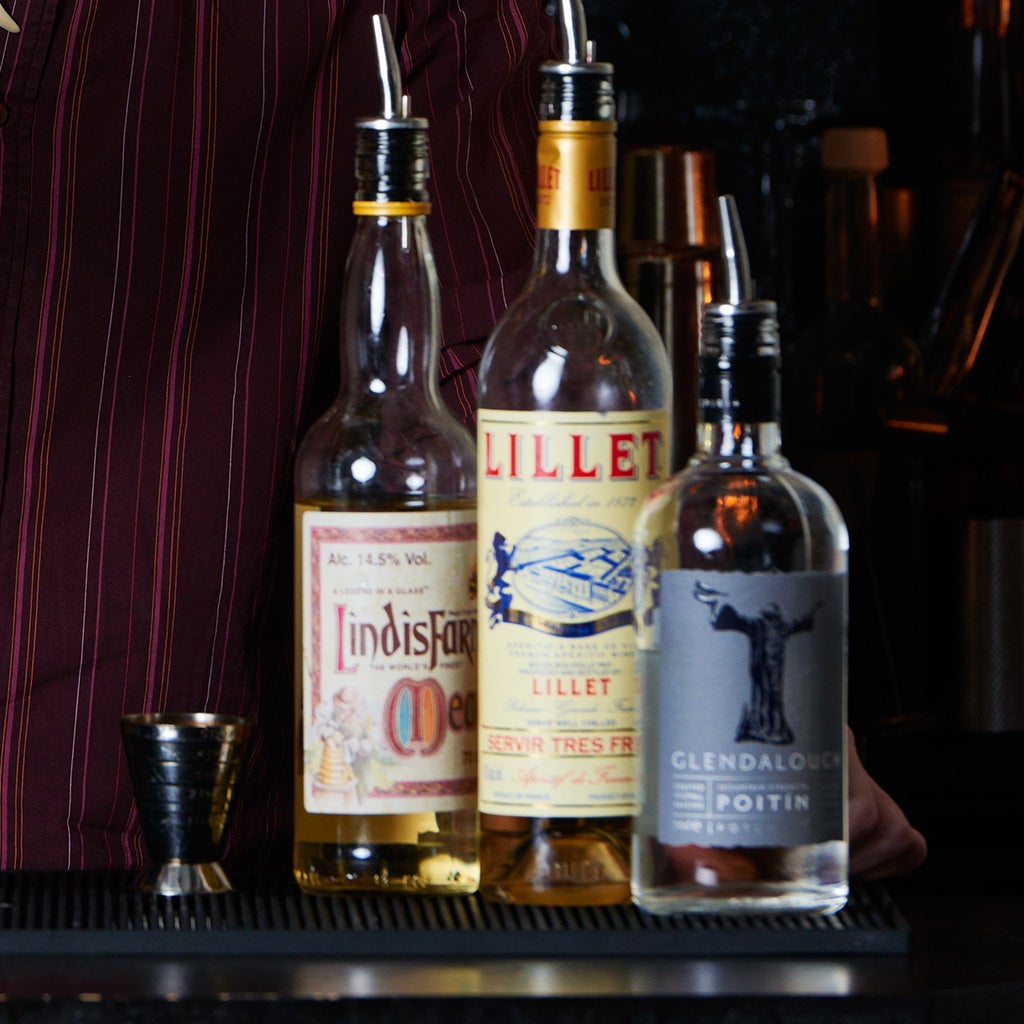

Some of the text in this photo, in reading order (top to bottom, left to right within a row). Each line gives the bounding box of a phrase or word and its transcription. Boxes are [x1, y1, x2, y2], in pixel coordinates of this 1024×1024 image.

[484, 431, 664, 481] LILLET
[328, 551, 431, 567] Alc. 14.5% Vol.
[532, 678, 611, 696] LILLET
[487, 734, 544, 753] SERVIR
[551, 736, 605, 753] TRES
